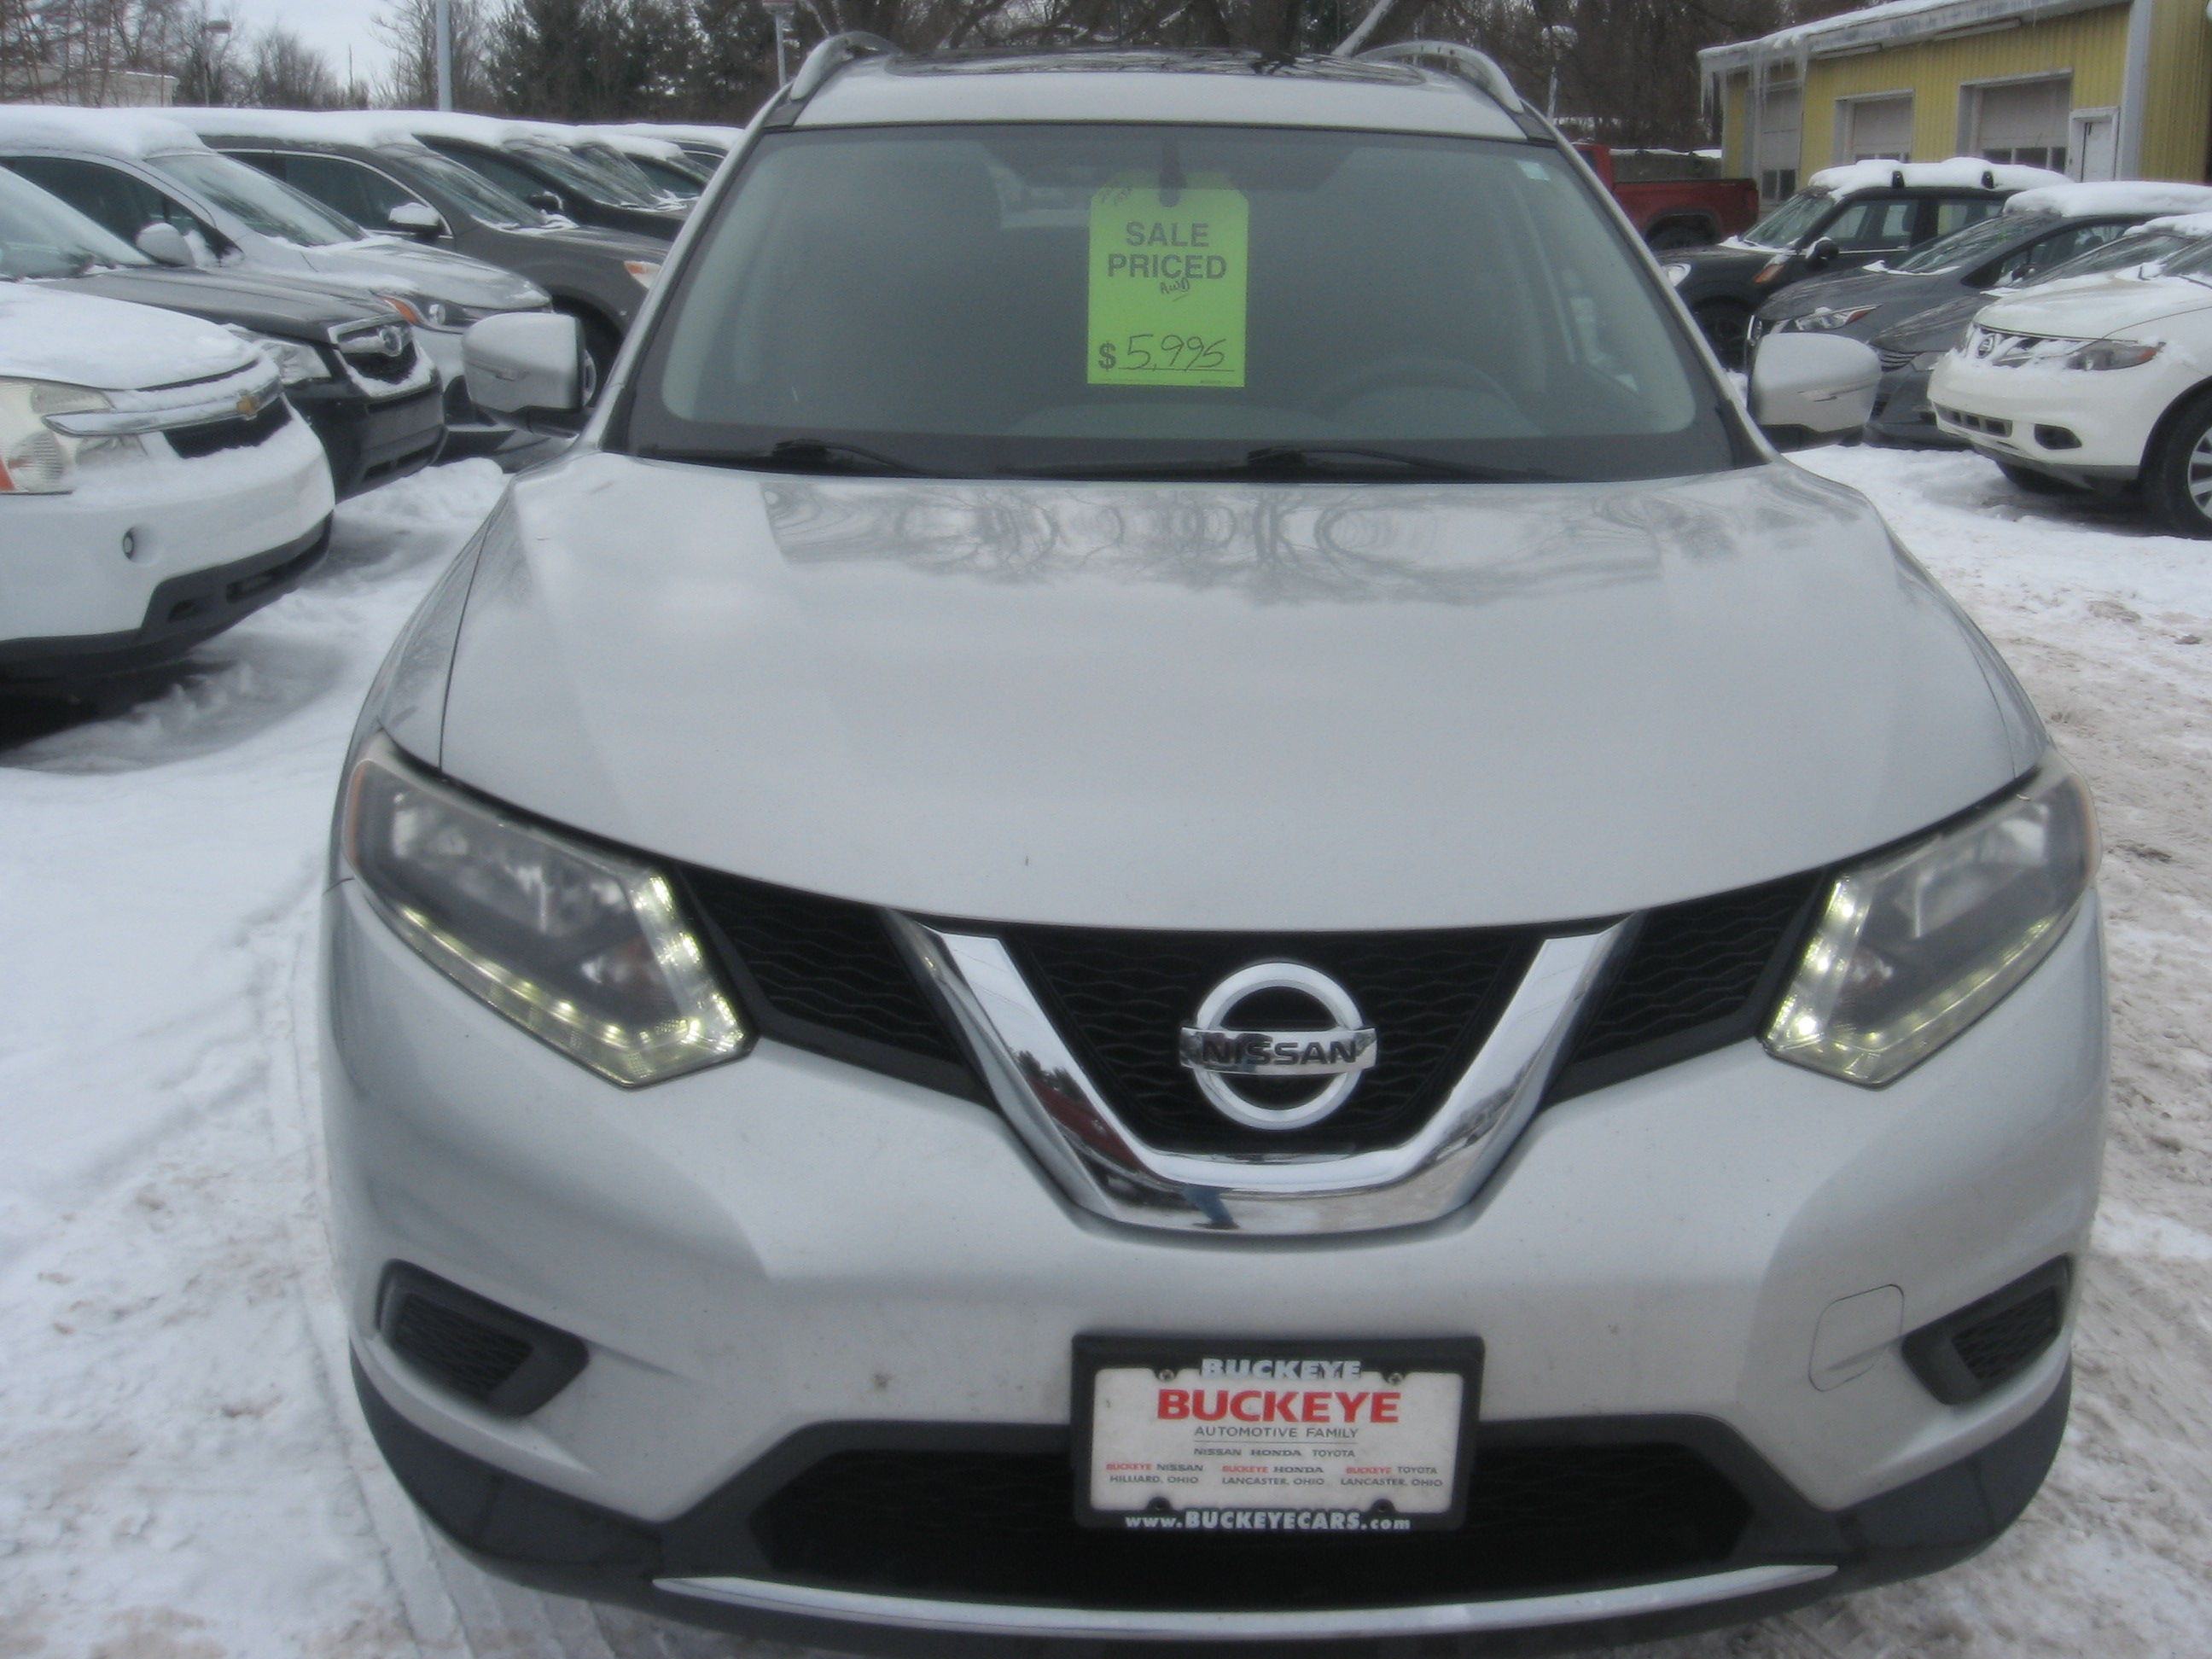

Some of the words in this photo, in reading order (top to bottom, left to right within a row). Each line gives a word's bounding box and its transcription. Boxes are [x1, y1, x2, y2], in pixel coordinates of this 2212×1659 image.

[1126, 220, 1209, 247] SALE
[1108, 253, 1227, 279] PRICED
[1202, 1039, 1357, 1065] NISSAN
[1200, 1359, 1361, 1380] BUCKEYE
[1156, 1388, 1401, 1423] BUCKEYE
[1195, 1427, 1297, 1438] AUTOMOTIVE
[1306, 1428, 1359, 1440] FAMILY
[1194, 1448, 1242, 1457] NISSAN
[1250, 1449, 1302, 1458] HONDA
[1312, 1450, 1356, 1458] TOYOTA
[1156, 1464, 1203, 1472] NISSAN
[1397, 1466, 1438, 1475] TOYOTA
[1293, 1477, 1325, 1486] OHIO
[1411, 1479, 1444, 1487] OHIO
[1126, 1511, 1412, 1531] www.BUCKEYECARS.com
